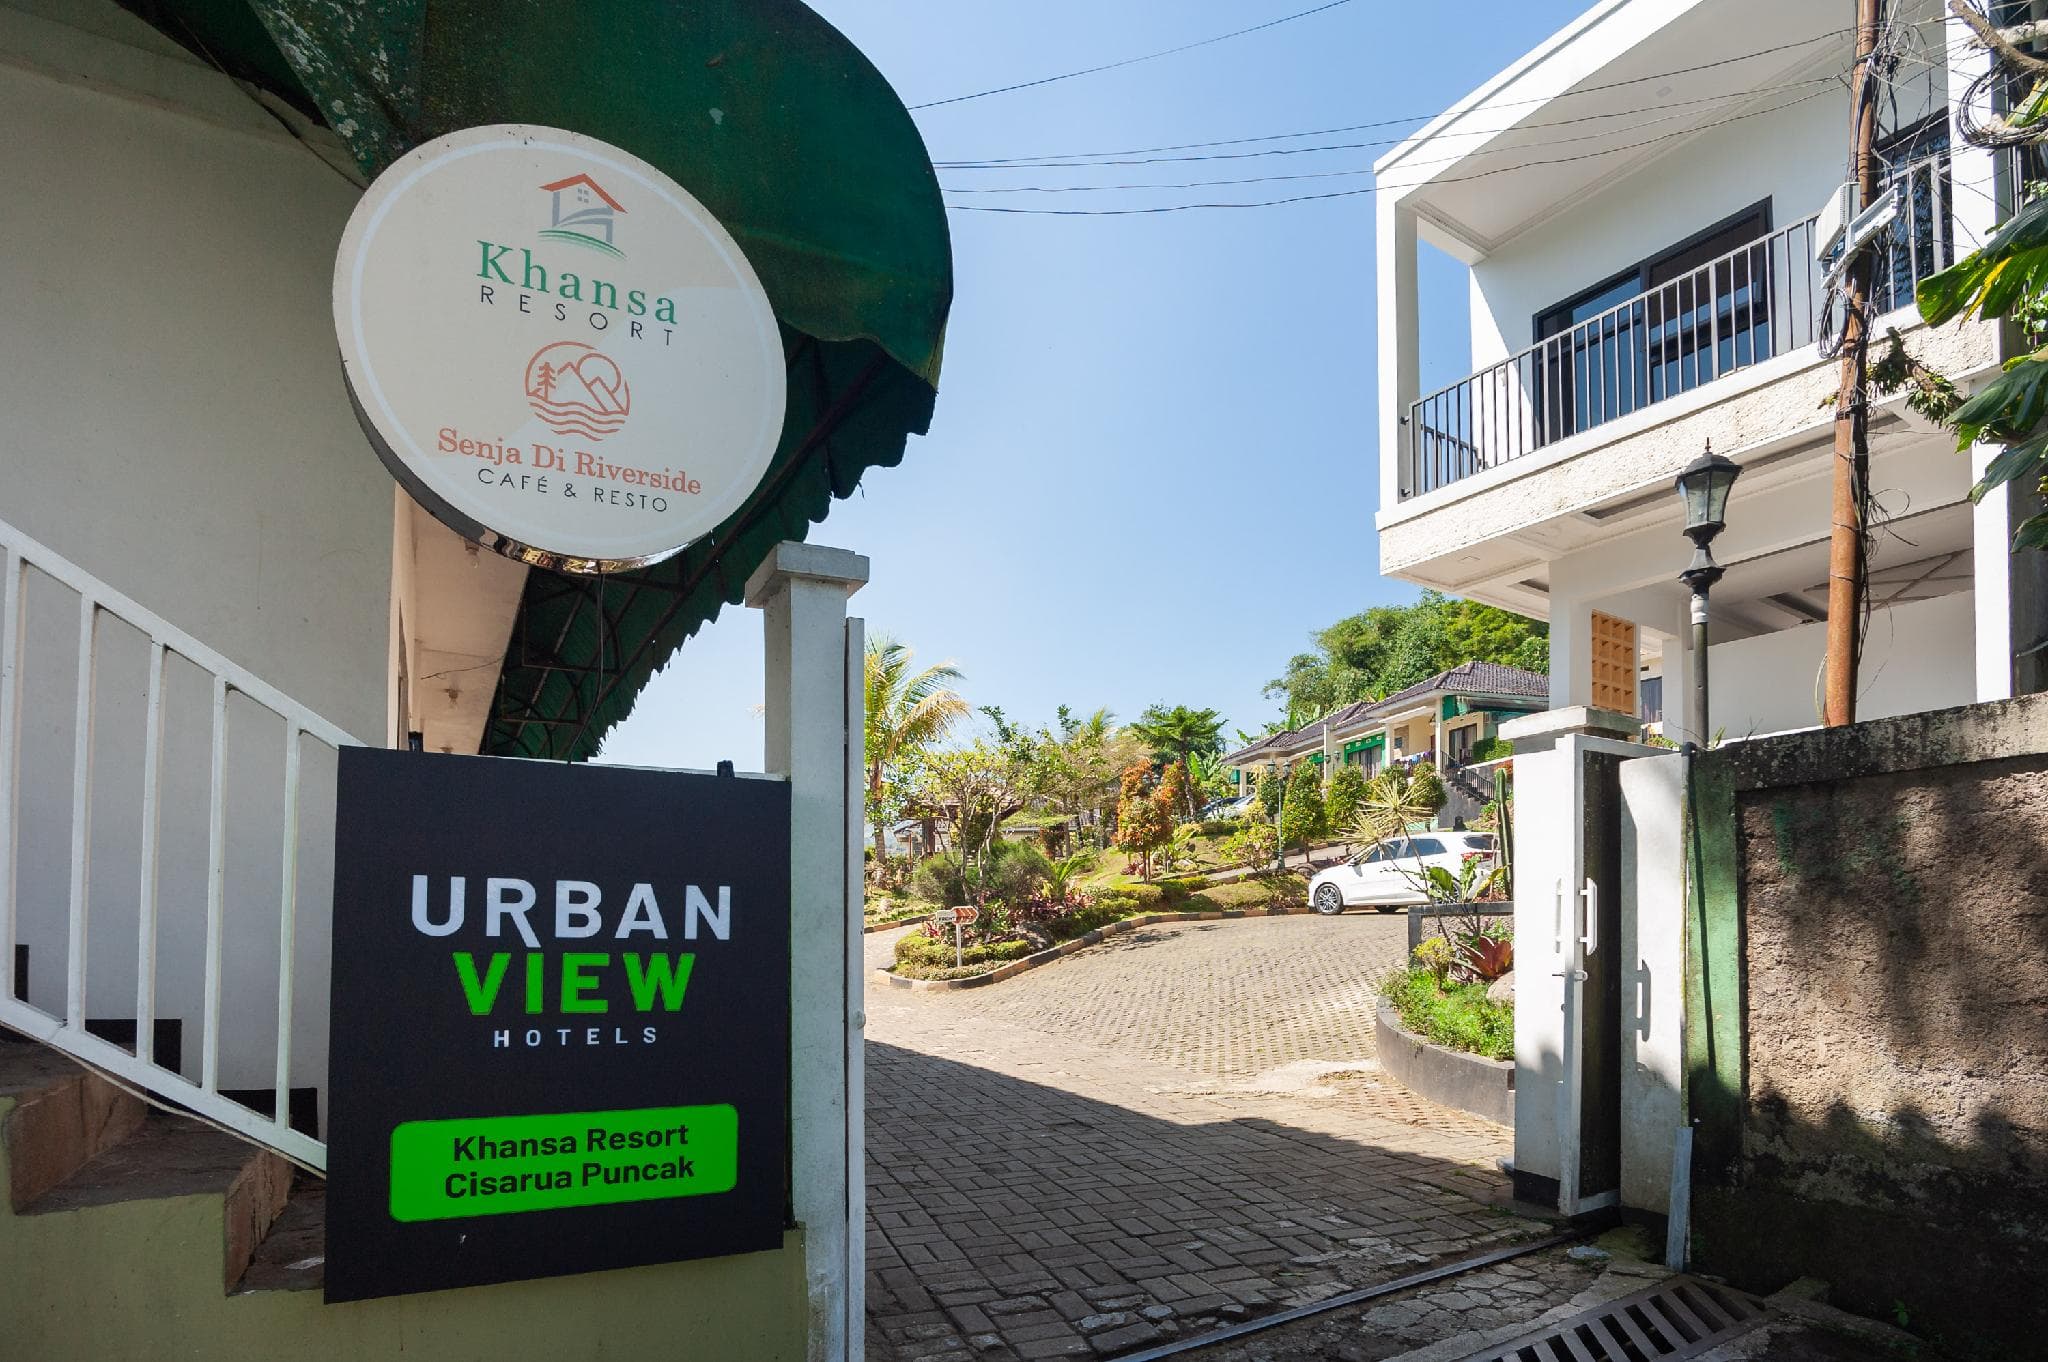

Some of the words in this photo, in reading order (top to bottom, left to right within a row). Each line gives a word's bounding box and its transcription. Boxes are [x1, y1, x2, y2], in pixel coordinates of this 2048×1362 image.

[476, 239, 679, 325] Khansa
[480, 284, 674, 346] RESORT
[437, 427, 522, 466] Senja
[531, 442, 566, 473] Di
[574, 451, 702, 495] Riverside
[477, 467, 548, 493] CAFÉ
[563, 482, 577, 498] &
[593, 487, 668, 513] RESTO
[410, 873, 731, 949] URBAN
[452, 951, 697, 1016] VIEW
[493, 1026, 657, 1048] HOTELS
[452, 1133, 577, 1162] Khansa
[585, 1123, 689, 1154] Resort
[444, 1167, 572, 1199] Cisarua
[581, 1155, 695, 1188] Puncak
